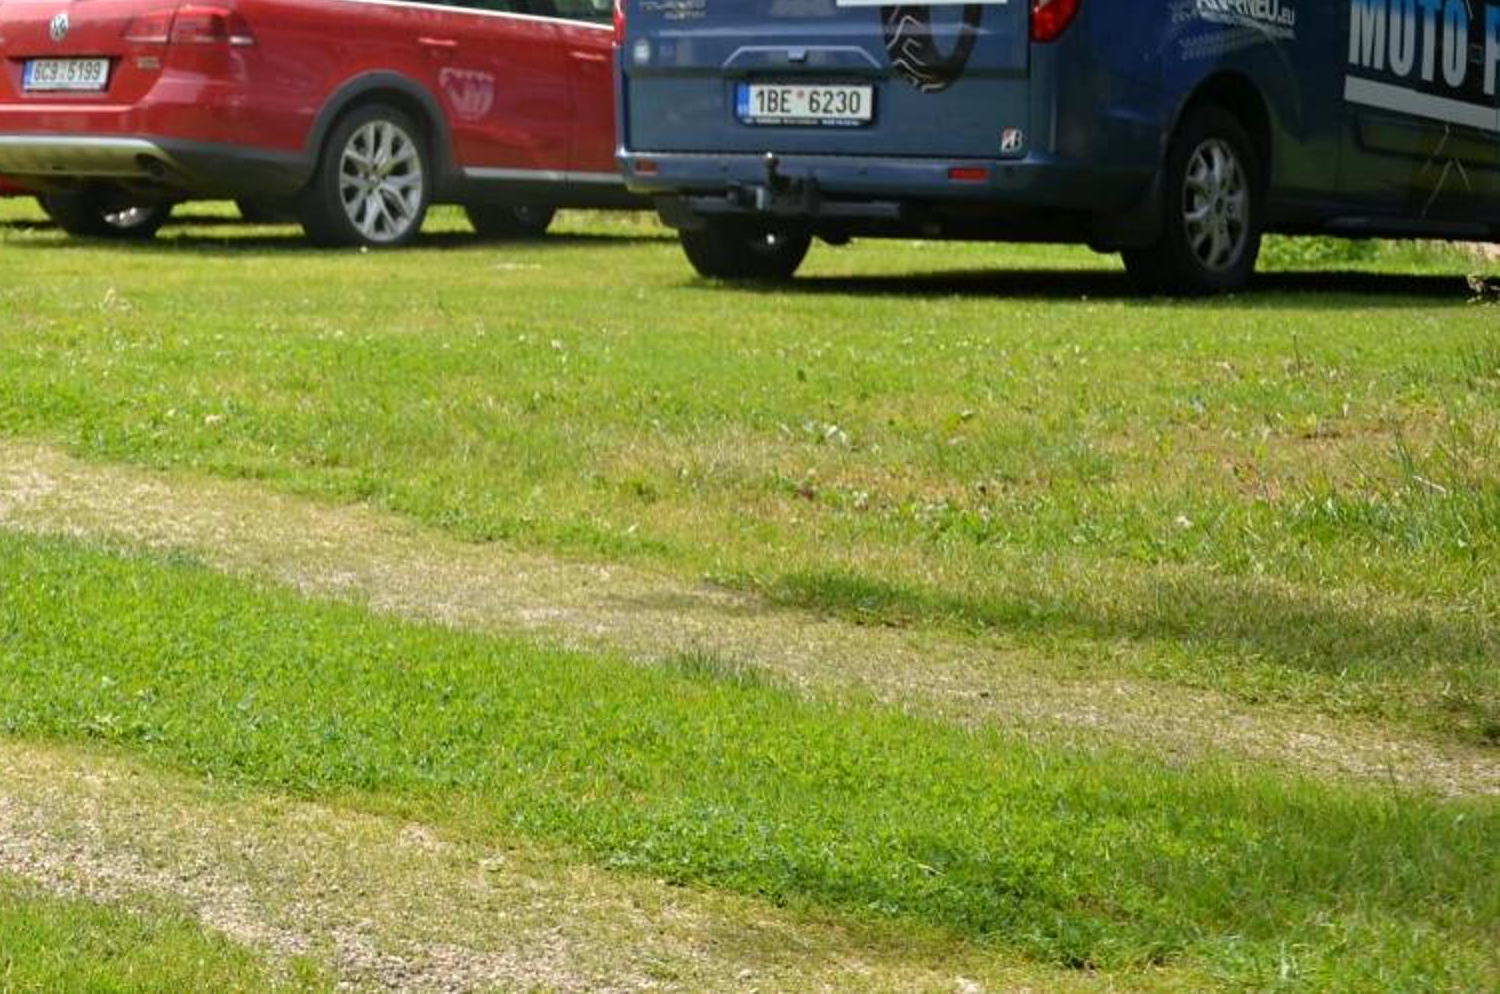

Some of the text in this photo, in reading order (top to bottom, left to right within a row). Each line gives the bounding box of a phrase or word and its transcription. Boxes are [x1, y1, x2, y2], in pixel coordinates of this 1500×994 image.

[68, 61, 102, 81] 5199
[755, 89, 862, 114] 1BE 6230
